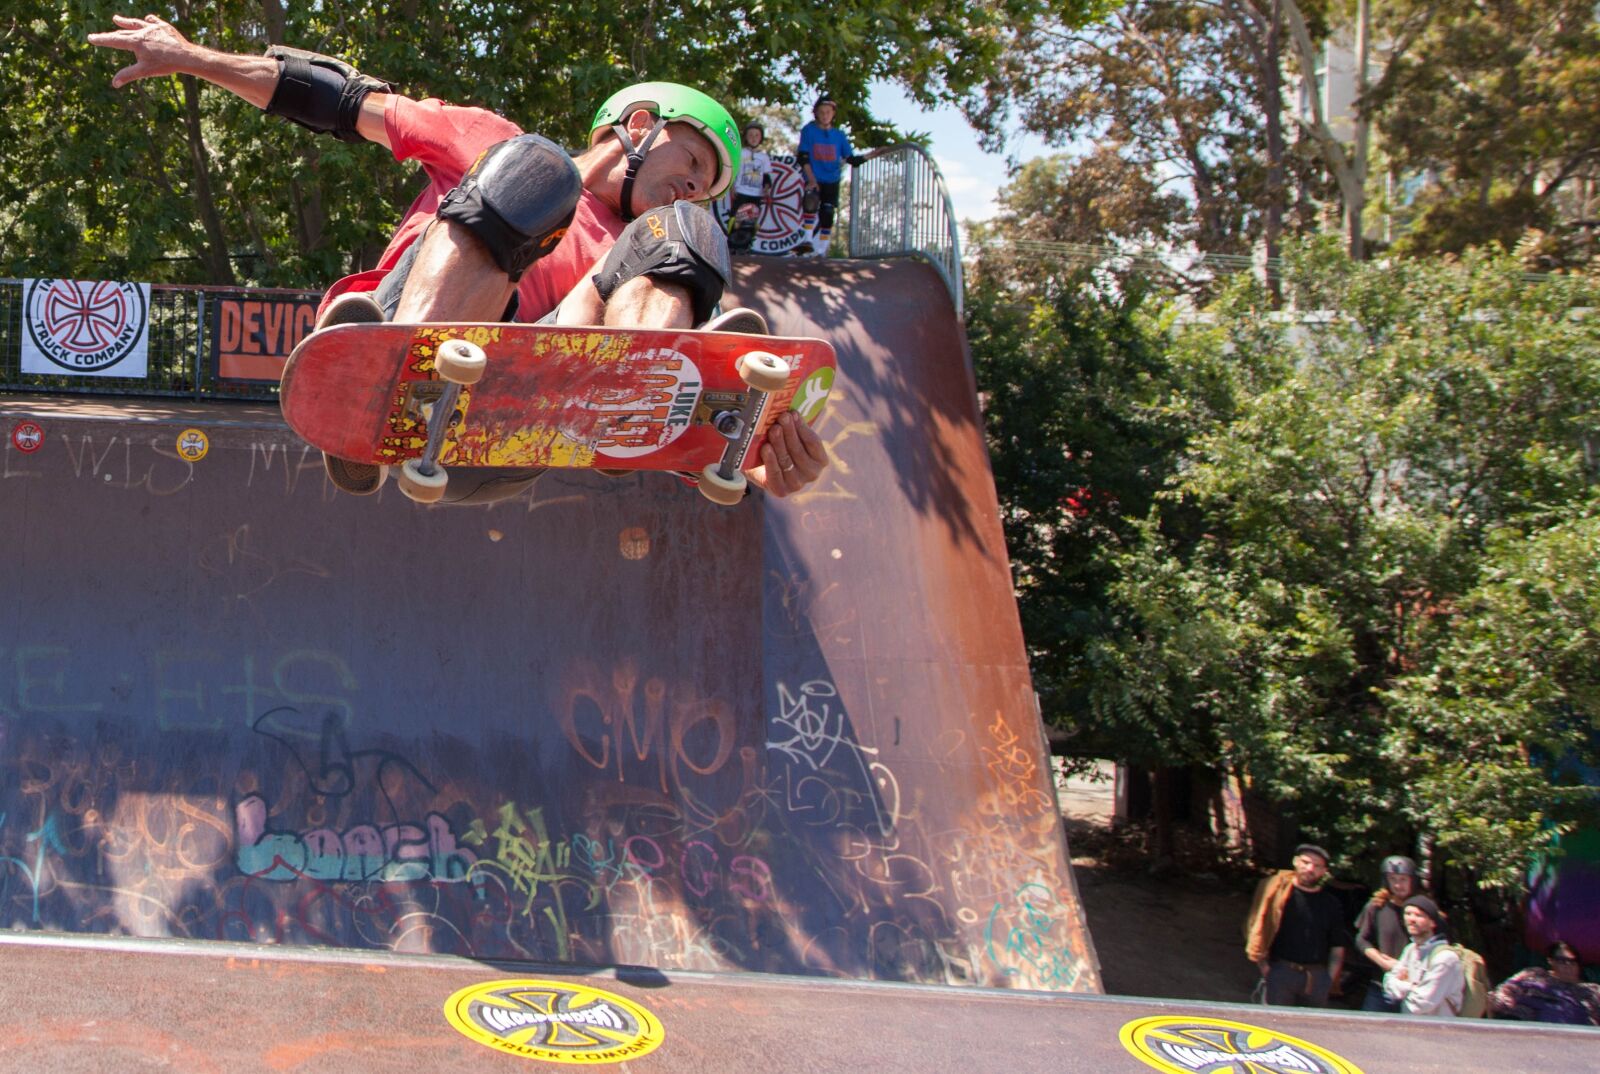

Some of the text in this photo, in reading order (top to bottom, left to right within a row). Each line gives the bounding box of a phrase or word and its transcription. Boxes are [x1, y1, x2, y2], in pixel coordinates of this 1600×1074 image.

[35, 320, 134, 365] TRUCK COMPANY
[220, 300, 315, 355] DEVIC
[668, 381, 700, 427] LUKE
[490, 1036, 654, 1061] TRUCK COMPANY
